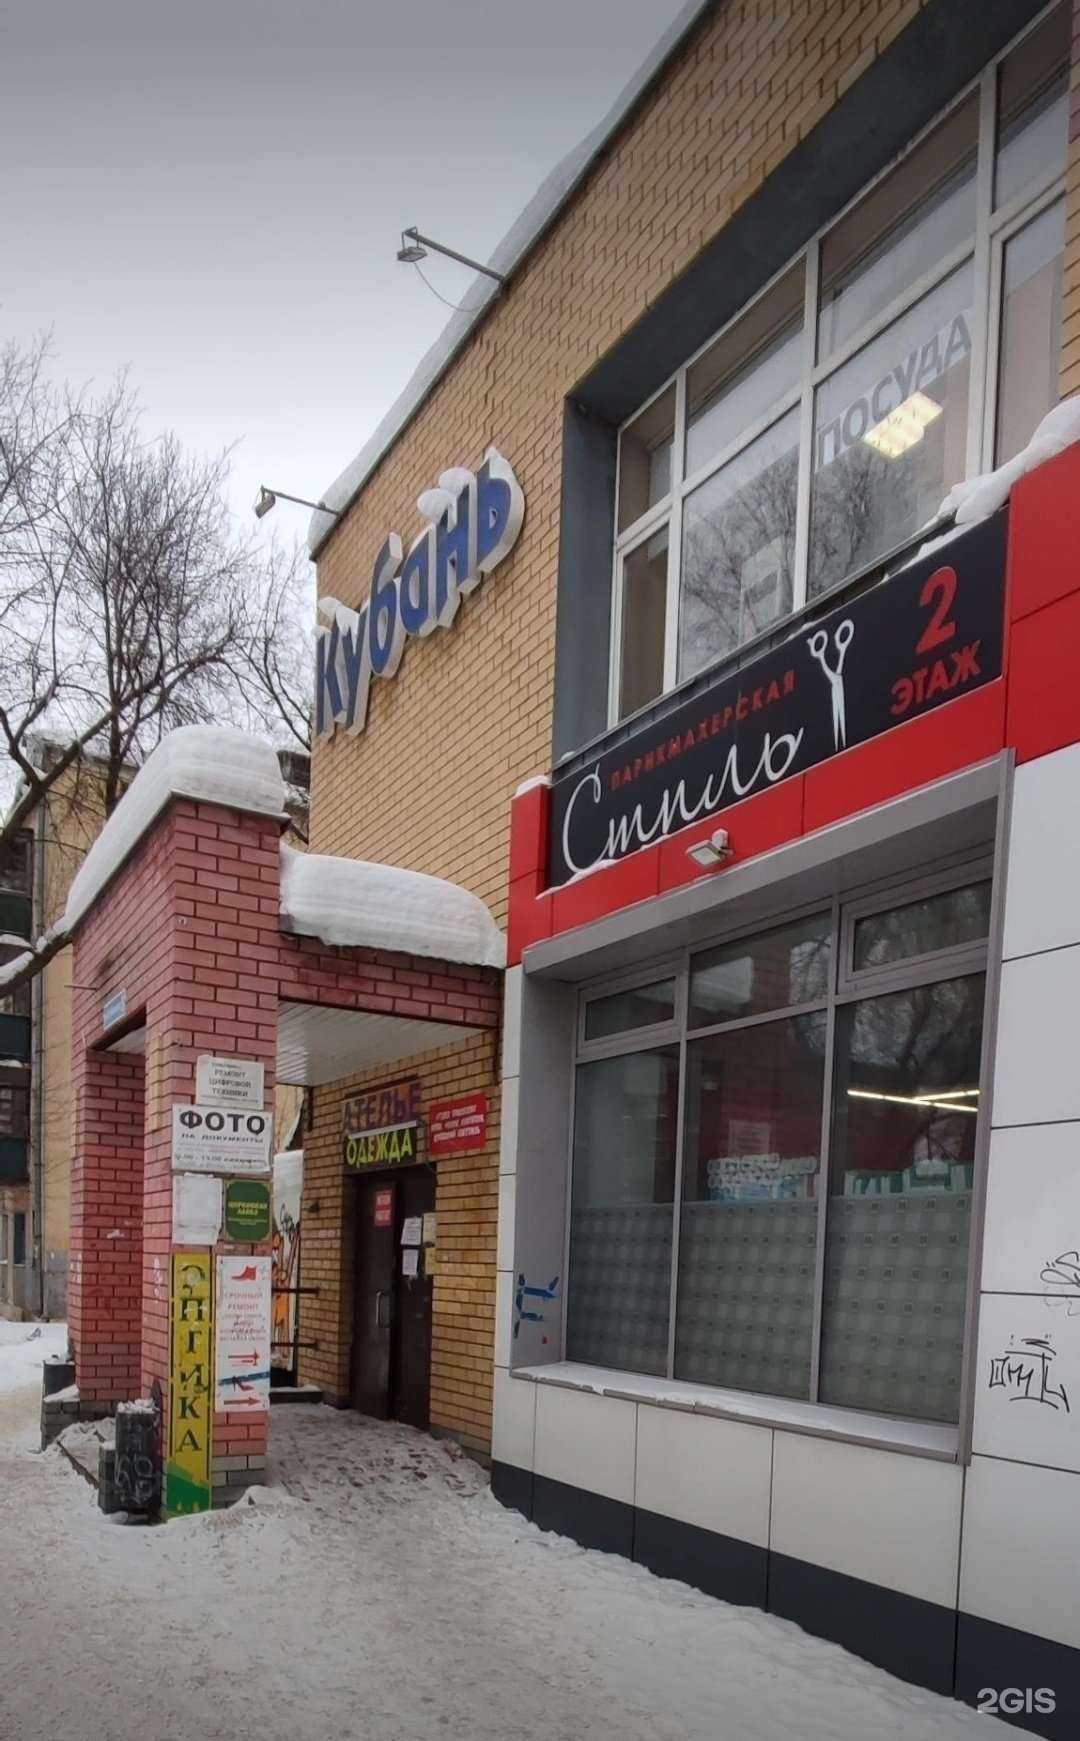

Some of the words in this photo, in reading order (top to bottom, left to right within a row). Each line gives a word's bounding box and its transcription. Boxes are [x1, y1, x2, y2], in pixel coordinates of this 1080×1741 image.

[817, 313, 972, 470] ПОСУДА
[914, 566, 958, 655] 2
[889, 640, 981, 716] ЭТАЖ
[610, 669, 796, 791] ПАРИКМАХЕРСКАЯ
[180, 1110, 265, 1135] ФОТО
[346, 1129, 413, 1168] ОДЕЖДА
